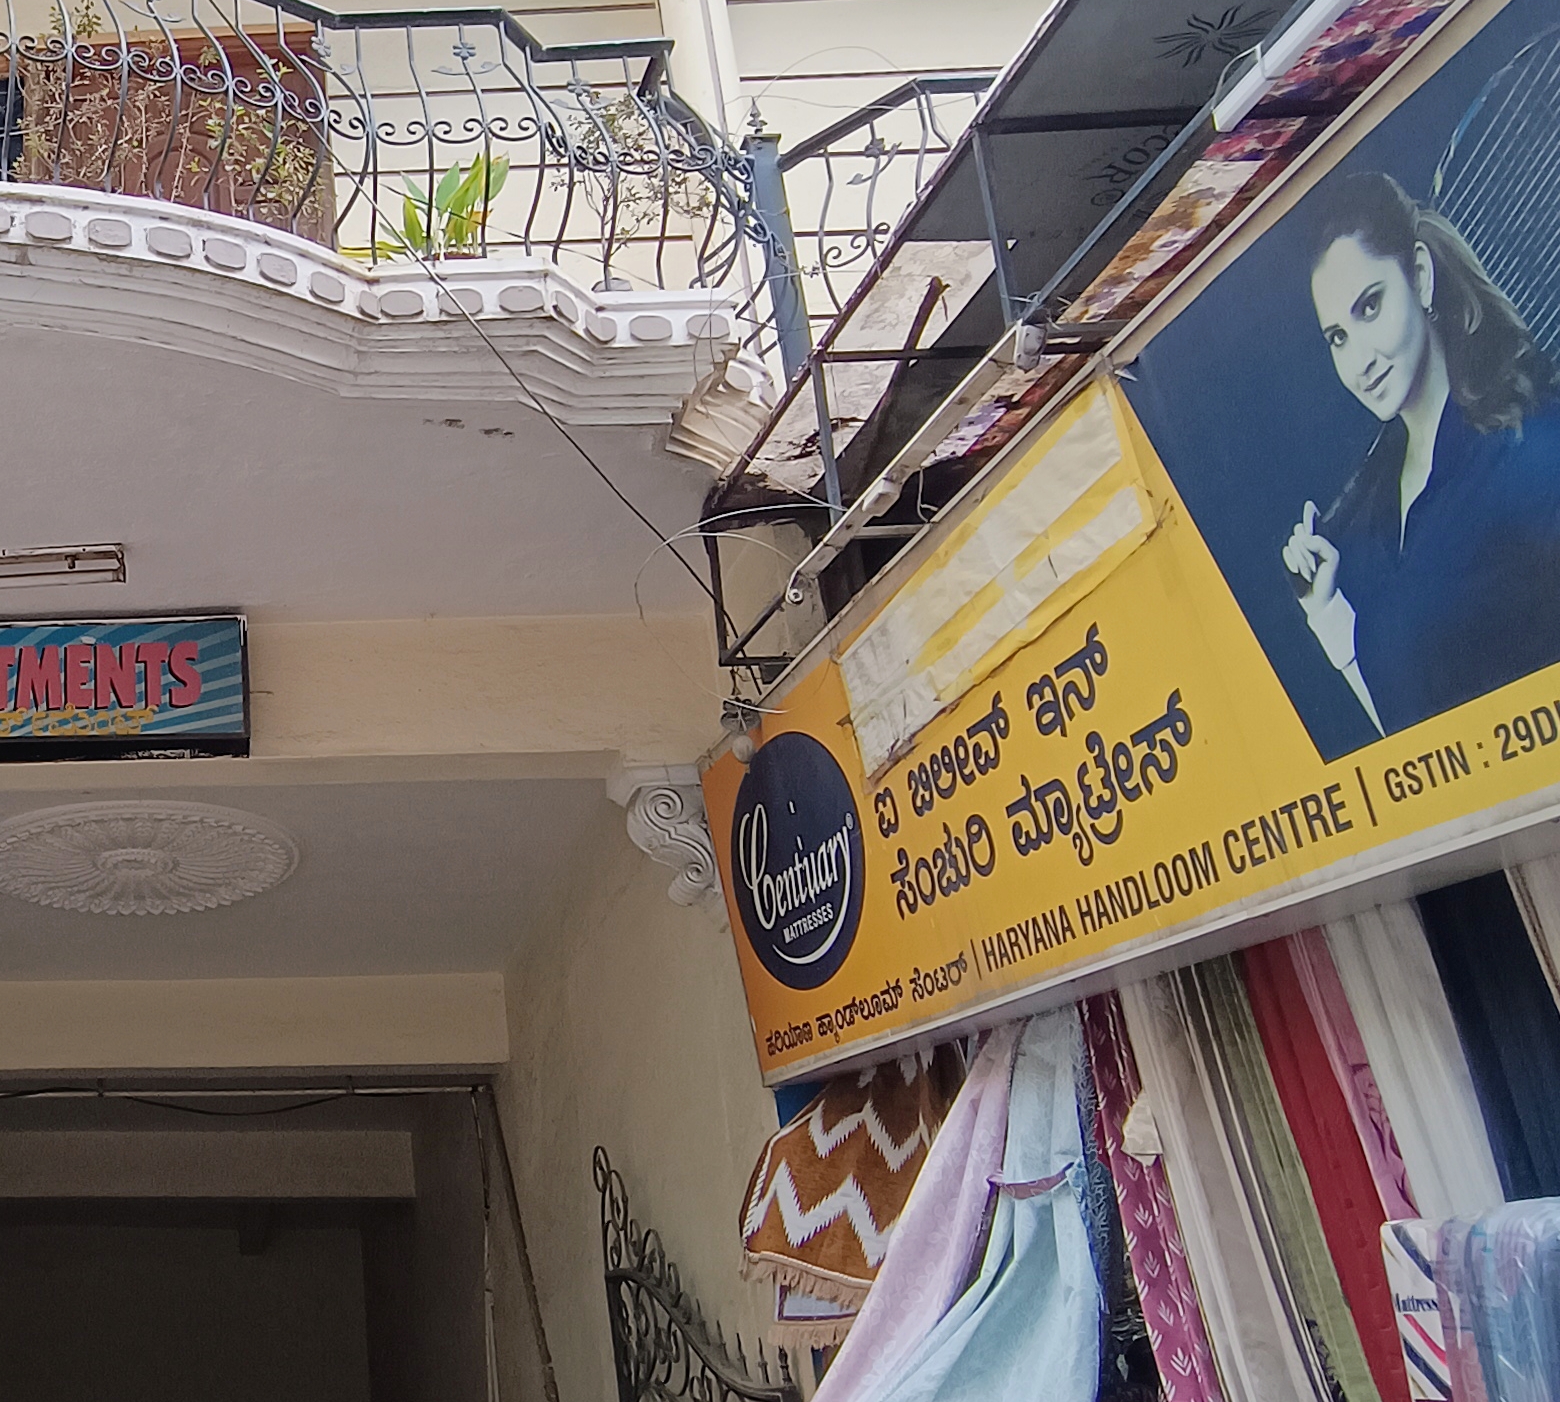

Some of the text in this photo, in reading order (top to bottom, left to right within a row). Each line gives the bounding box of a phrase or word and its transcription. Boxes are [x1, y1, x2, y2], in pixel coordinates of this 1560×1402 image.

[874, 621, 1108, 839] ಐ ಬಿಲೀವ್ ಇನ್
[1383, 740, 1472, 803] GSTIN
[1493, 699, 1560, 762] 29D
[889, 813, 996, 921] ಸೆಂಚುರಿ
[982, 782, 1354, 972] HARYANA HANDLOOM CENTRE
[782, 902, 834, 944] MATTRESSES
[909, 950, 968, 1003] ಸೆಂಟರ್
